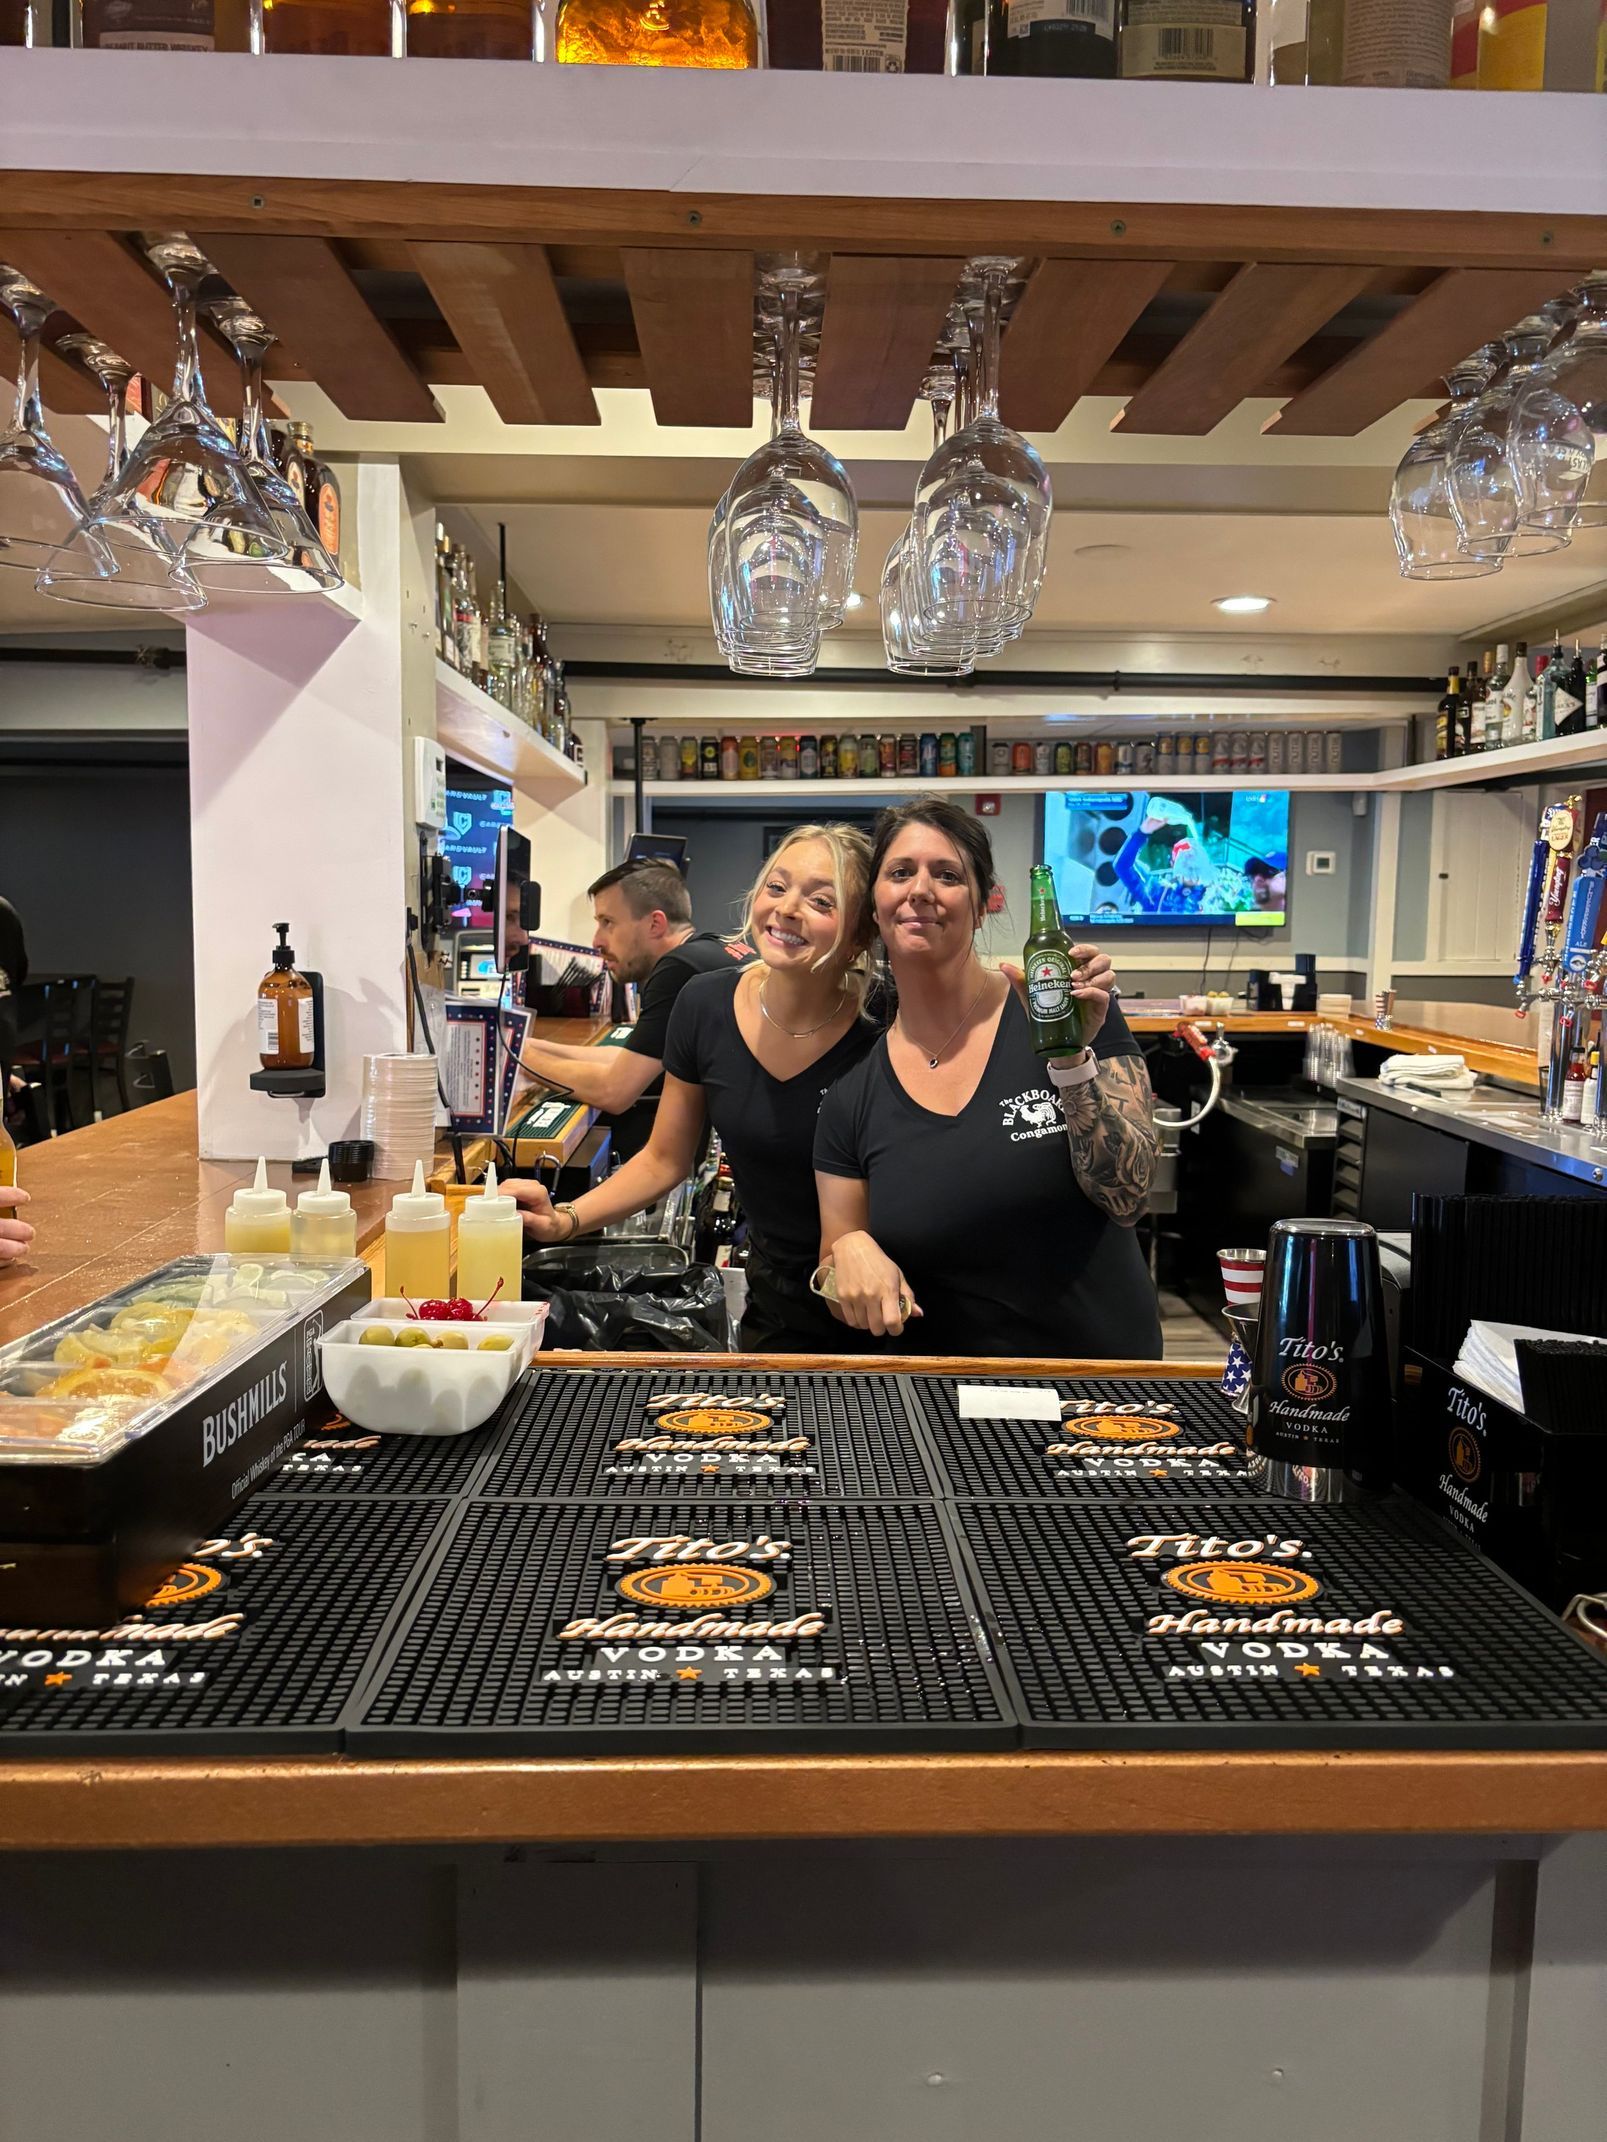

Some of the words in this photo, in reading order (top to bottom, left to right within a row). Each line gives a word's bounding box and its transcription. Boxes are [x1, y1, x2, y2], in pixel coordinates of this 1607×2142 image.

[446, 789, 487, 801] ARDVAULT
[1028, 979, 1072, 994] Heineken
[999, 1098, 1013, 1108] The
[1002, 1089, 1065, 1126] BLACKBOAR
[202, 1360, 288, 1469] BUSHMILLS
[1268, 1400, 1351, 1422] Handmade
[1275, 1431, 1300, 1440] AUSTIN
[1286, 1422, 1329, 1434] VODKA
[614, 1435, 811, 1451] Handmade
[1047, 1441, 1237, 1456] Handmade
[231, 1469, 250, 1500] Official
[249, 1451, 271, 1483] Whiskey
[283, 1432, 294, 1453] PGA
[293, 1418, 306, 1444] TOUR
[646, 1453, 778, 1463] VODKA
[1084, 1458, 1220, 1468] VODKA
[605, 1465, 689, 1473] AUSTIN
[735, 1465, 814, 1473] TEXAS
[1057, 1469, 1137, 1477] AUSTIN
[1439, 1474, 1489, 1523] Handmade
[1449, 1504, 1475, 1533] VODKA
[559, 1612, 826, 1639] Handmade
[1148, 1609, 1405, 1636] Handmade
[600, 1645, 783, 1663] VODKA
[1201, 1642, 1389, 1659] VODKA
[92, 1672, 206, 1685] TEXAS
[543, 1668, 659, 1681] AUSTIN
[724, 1667, 836, 1680] TEXAS
[1168, 1664, 1279, 1677] AUSTIN
[1341, 1665, 1455, 1678] TEXAS
